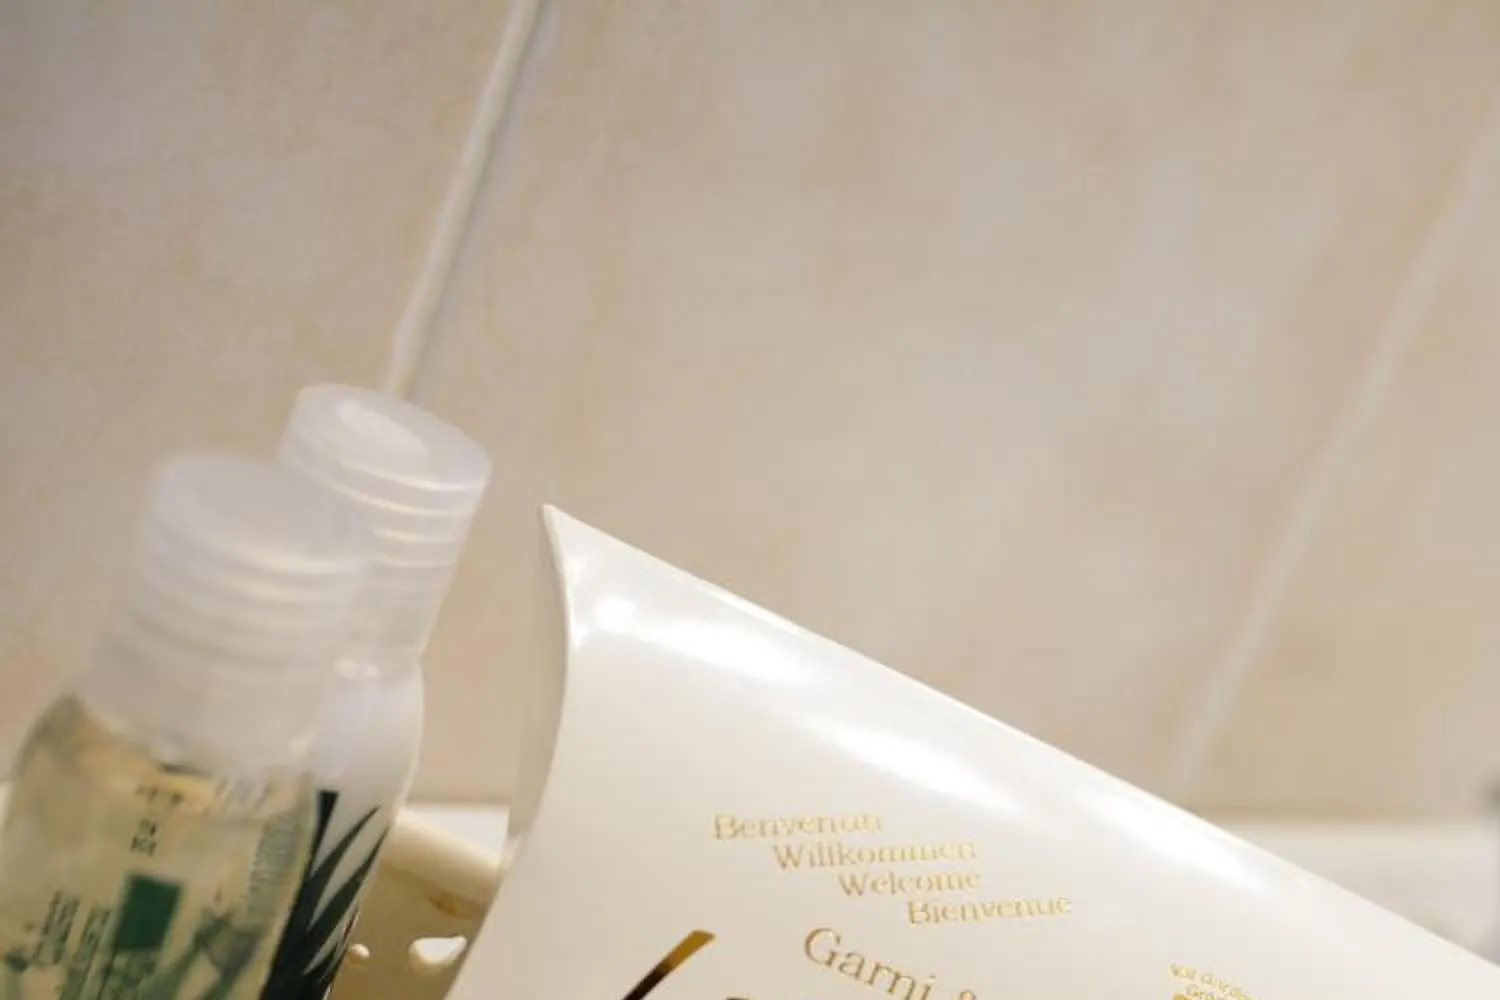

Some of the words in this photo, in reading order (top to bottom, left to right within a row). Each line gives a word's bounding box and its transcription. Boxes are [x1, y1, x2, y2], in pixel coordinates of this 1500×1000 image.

[772, 842, 977, 870] Willkommen
[838, 871, 980, 897] Welcome
[907, 897, 1072, 925] Bienvenue
